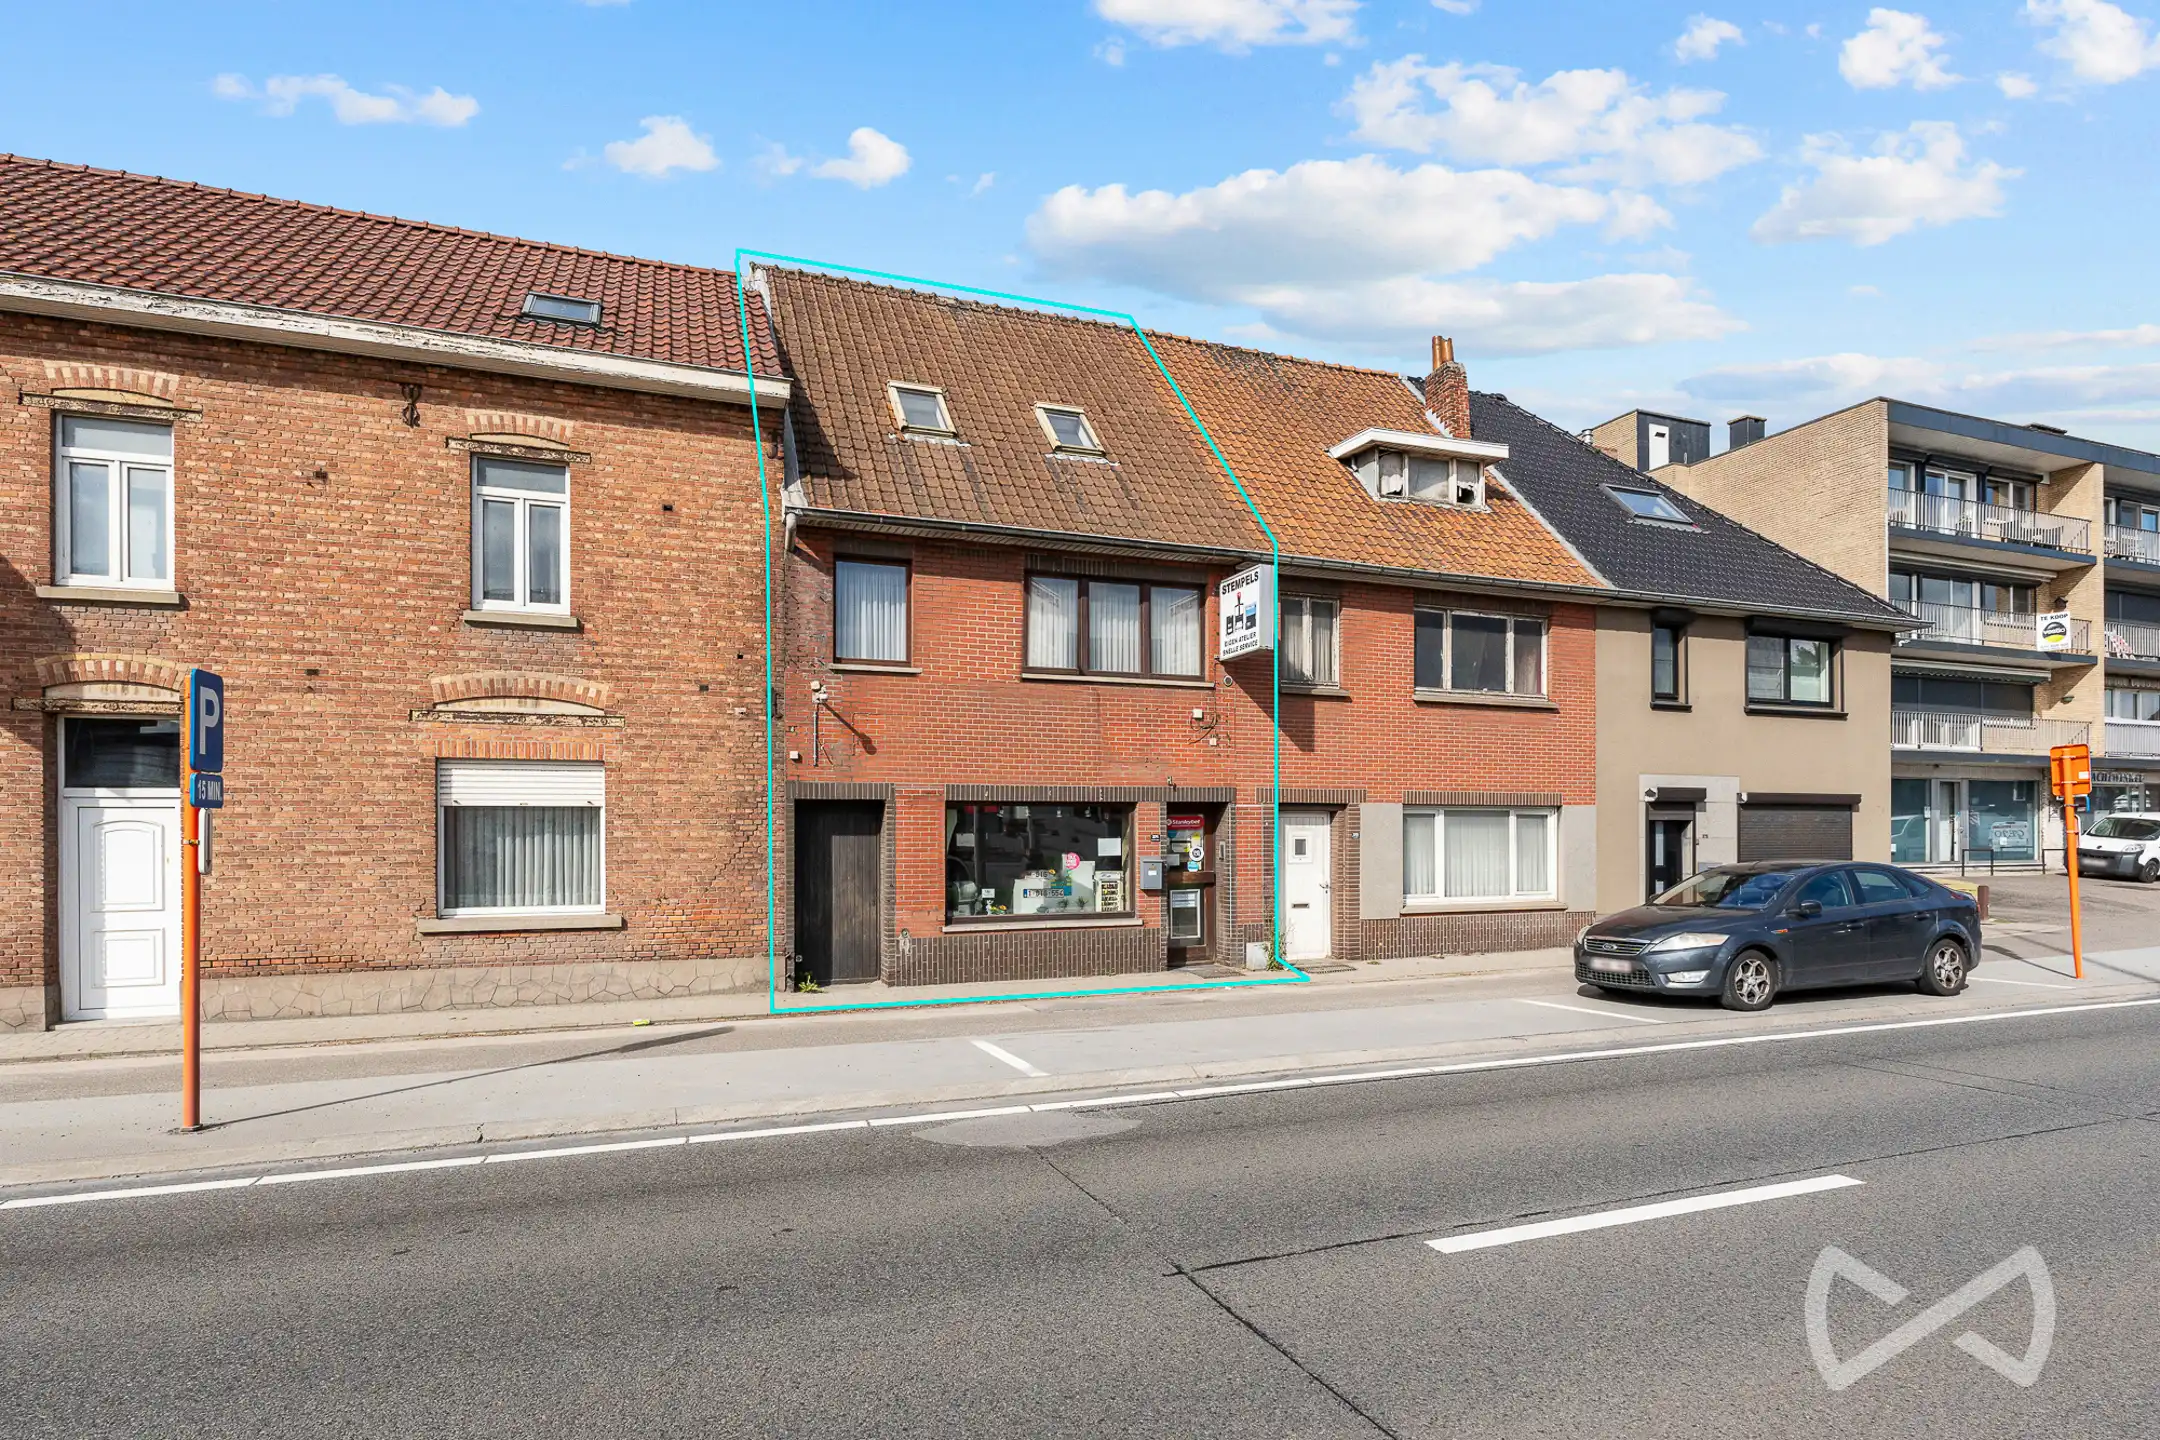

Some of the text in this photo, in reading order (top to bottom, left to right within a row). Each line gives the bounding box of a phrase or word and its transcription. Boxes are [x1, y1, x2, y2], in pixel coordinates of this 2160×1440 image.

[1221, 571, 1259, 595] STEMPELS
[1223, 639, 1258, 656] SNELLE SERVICE
[1239, 631, 1257, 643] ATELIER
[200, 686, 220, 755] P
[198, 779, 222, 801] 15 MIN.
